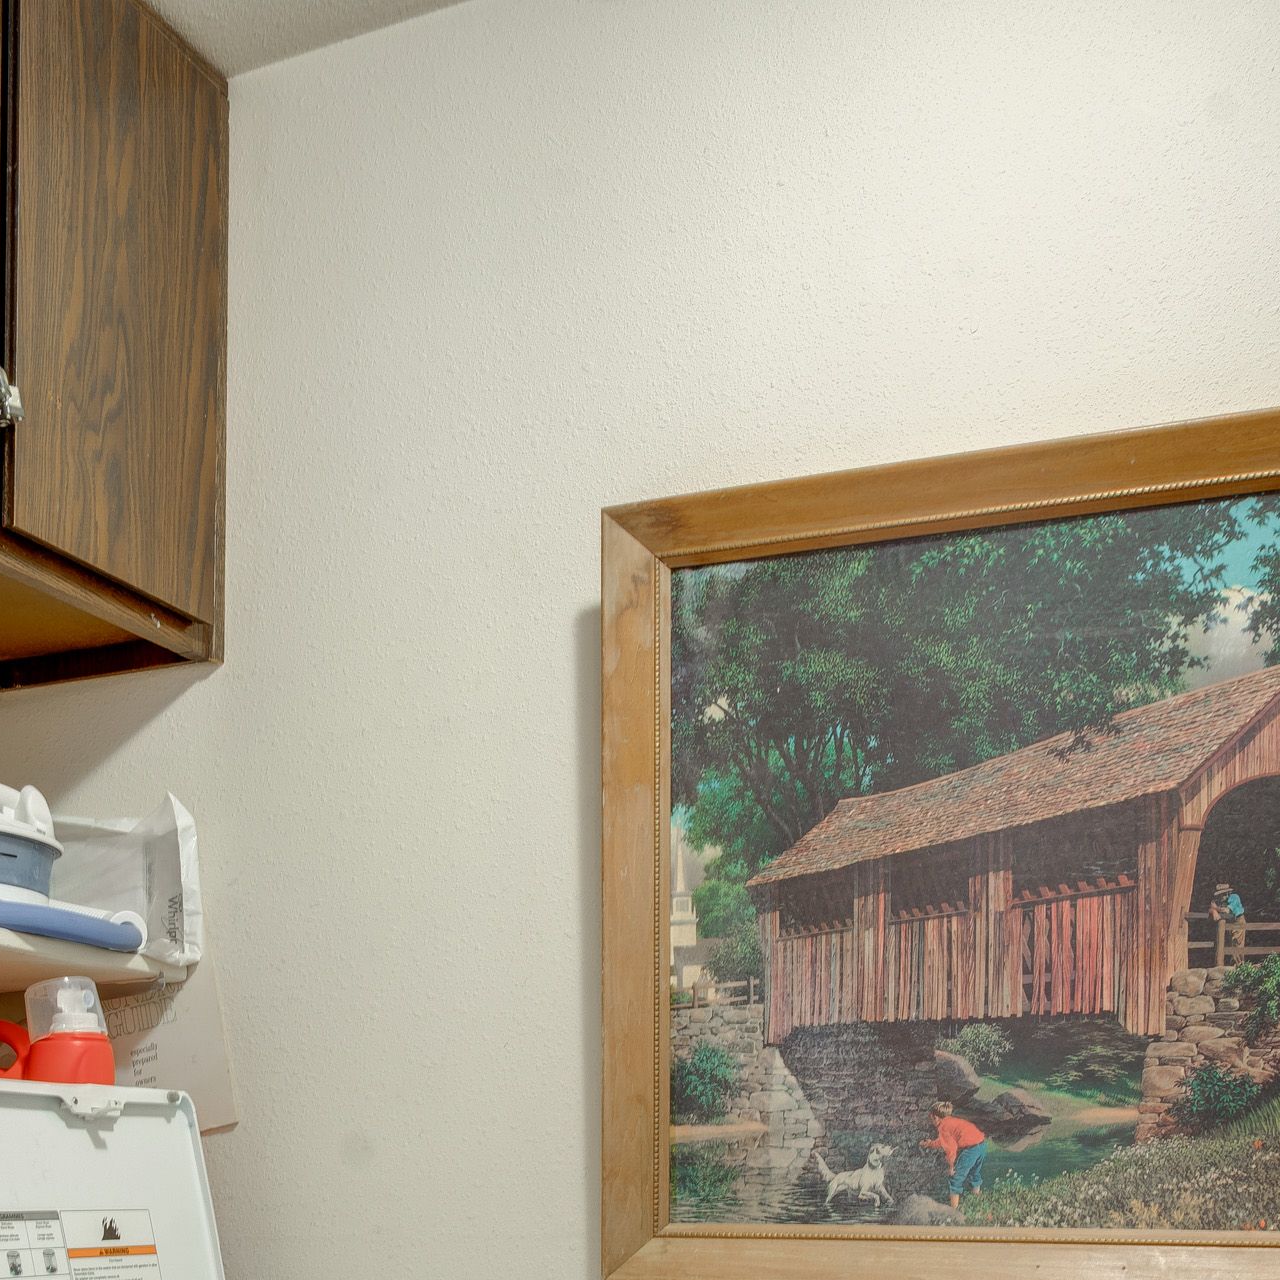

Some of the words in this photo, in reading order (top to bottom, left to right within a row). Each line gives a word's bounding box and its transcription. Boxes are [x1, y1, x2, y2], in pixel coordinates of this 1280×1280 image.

[130, 1042, 158, 1058] especially
[132, 1052, 158, 1068] prepared
[133, 1068, 142, 1077] for
[135, 1076, 157, 1086] owners
[104, 1247, 130, 1255] WARNING
